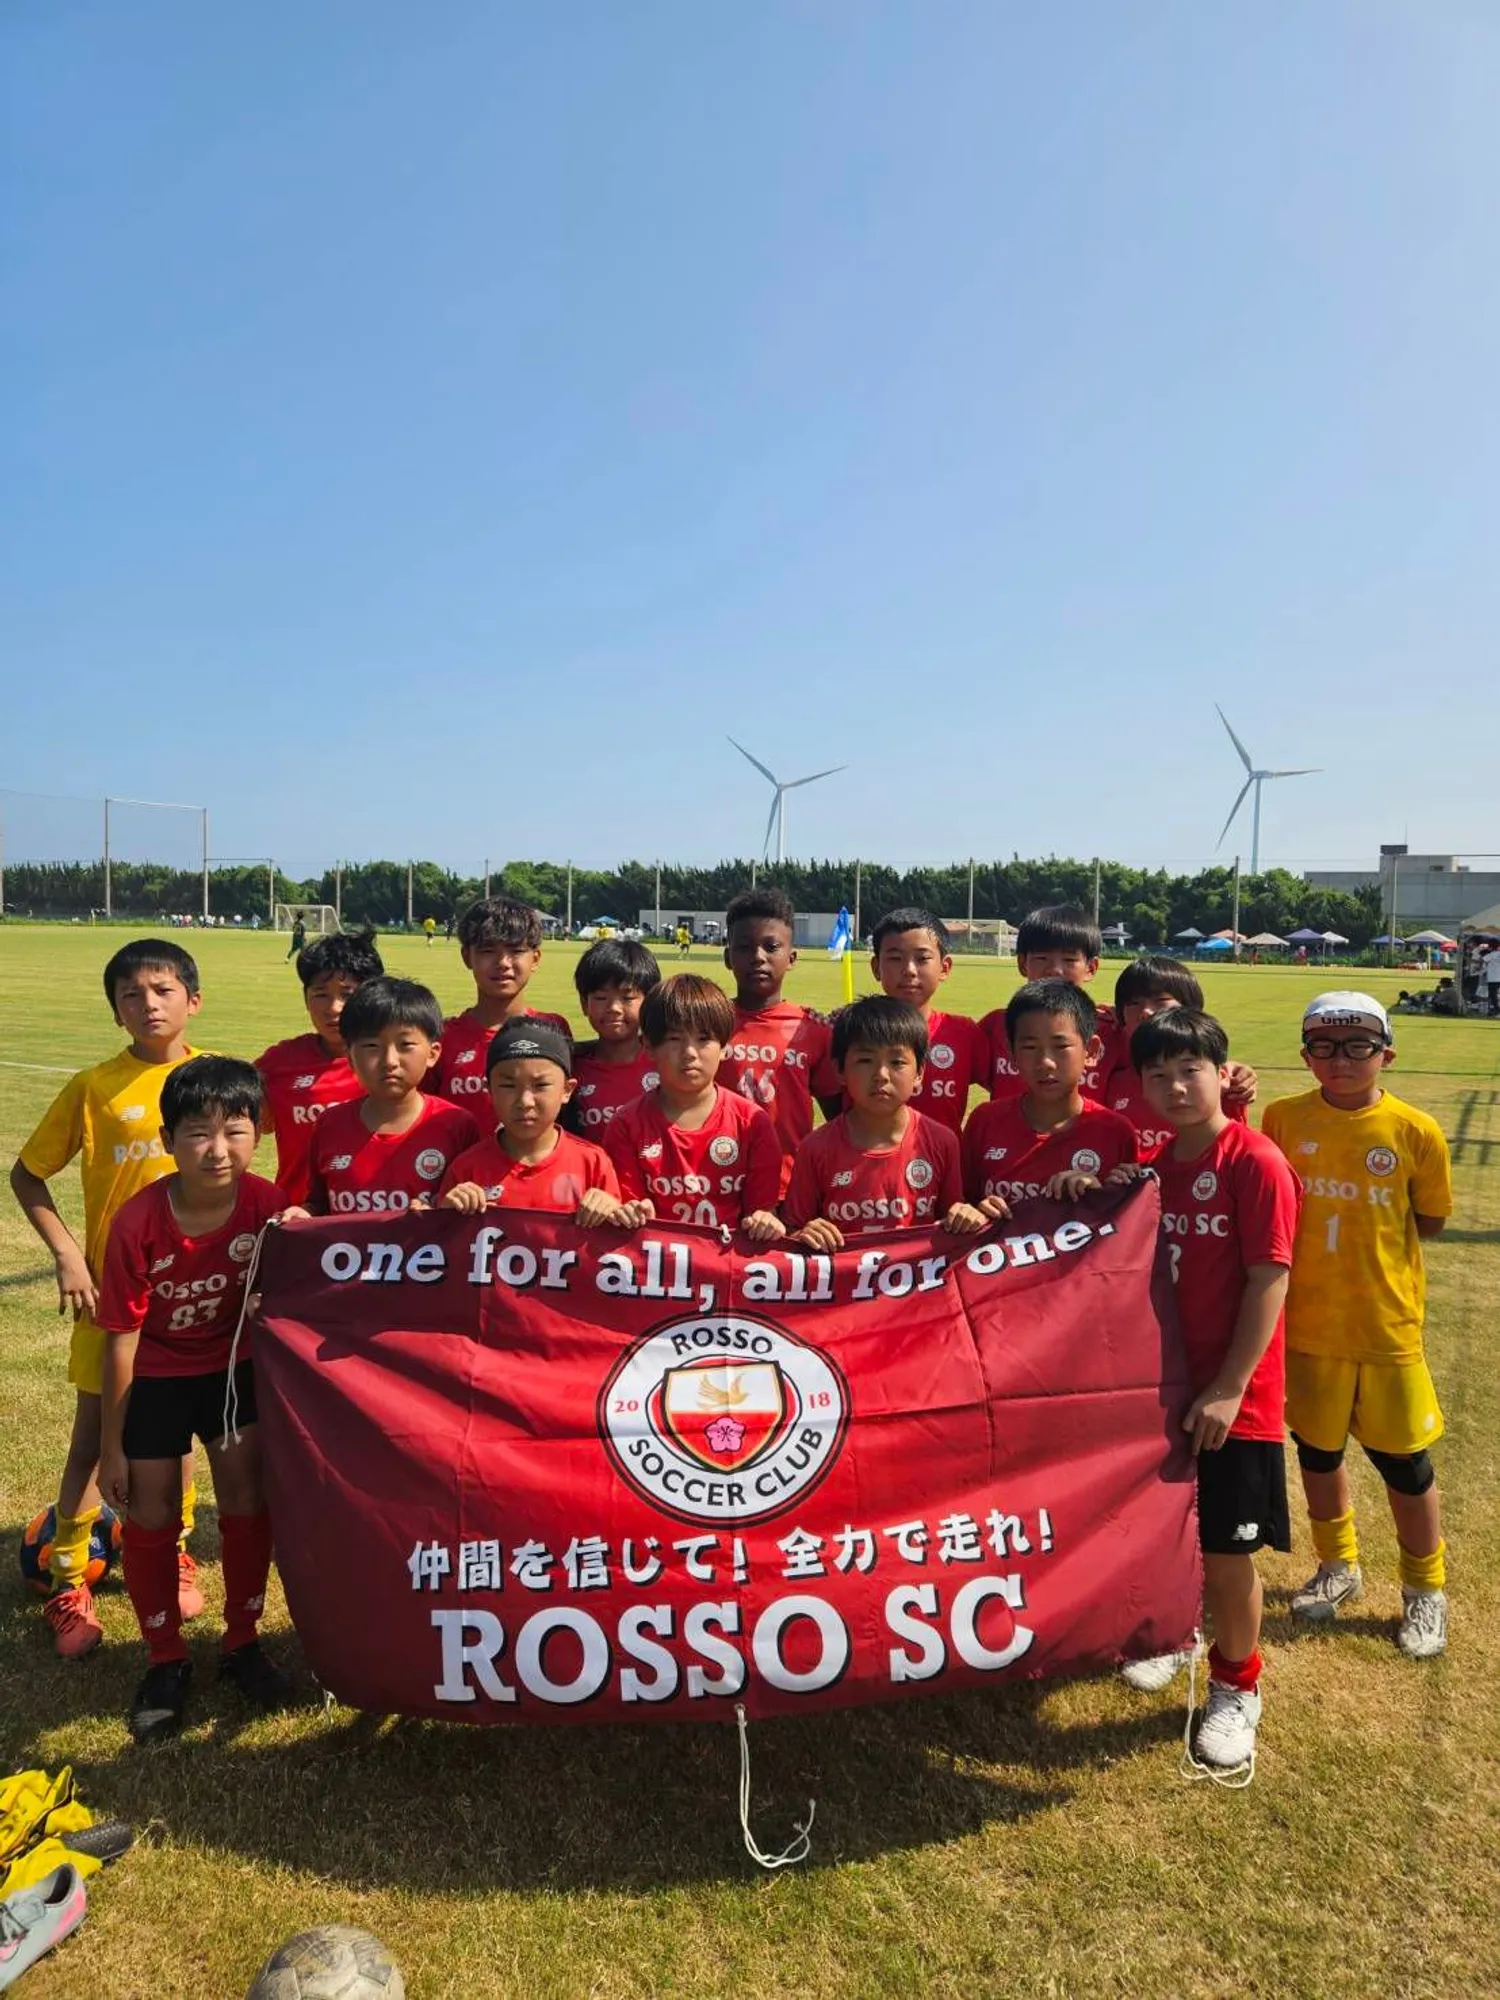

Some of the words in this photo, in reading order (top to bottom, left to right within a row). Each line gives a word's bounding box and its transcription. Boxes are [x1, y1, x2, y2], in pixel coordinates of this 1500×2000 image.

[737, 1068, 776, 1104] 46
[932, 1080, 957, 1098] SC
[985, 1180, 1047, 1200] ROSS
[1368, 1185, 1393, 1206] SC
[828, 1197, 909, 1220] ROSSO
[1196, 1213, 1229, 1237] SC
[1326, 1214, 1339, 1252] 1
[321, 1240, 445, 1283] one
[467, 1227, 576, 1288] for
[597, 1241, 716, 1312] all,
[742, 1252, 833, 1300] all
[852, 1250, 950, 1300] for
[967, 1220, 1117, 1275] one.
[169, 1297, 223, 1331] 83
[671, 1327, 773, 1355] ROSSO
[614, 1400, 639, 1413] 20
[808, 1392, 831, 1409] 18
[629, 1439, 747, 1506] SOCCER
[755, 1428, 823, 1497] CLUB
[430, 1594, 849, 1704] ROSSO
[885, 1573, 1034, 1683] SC
